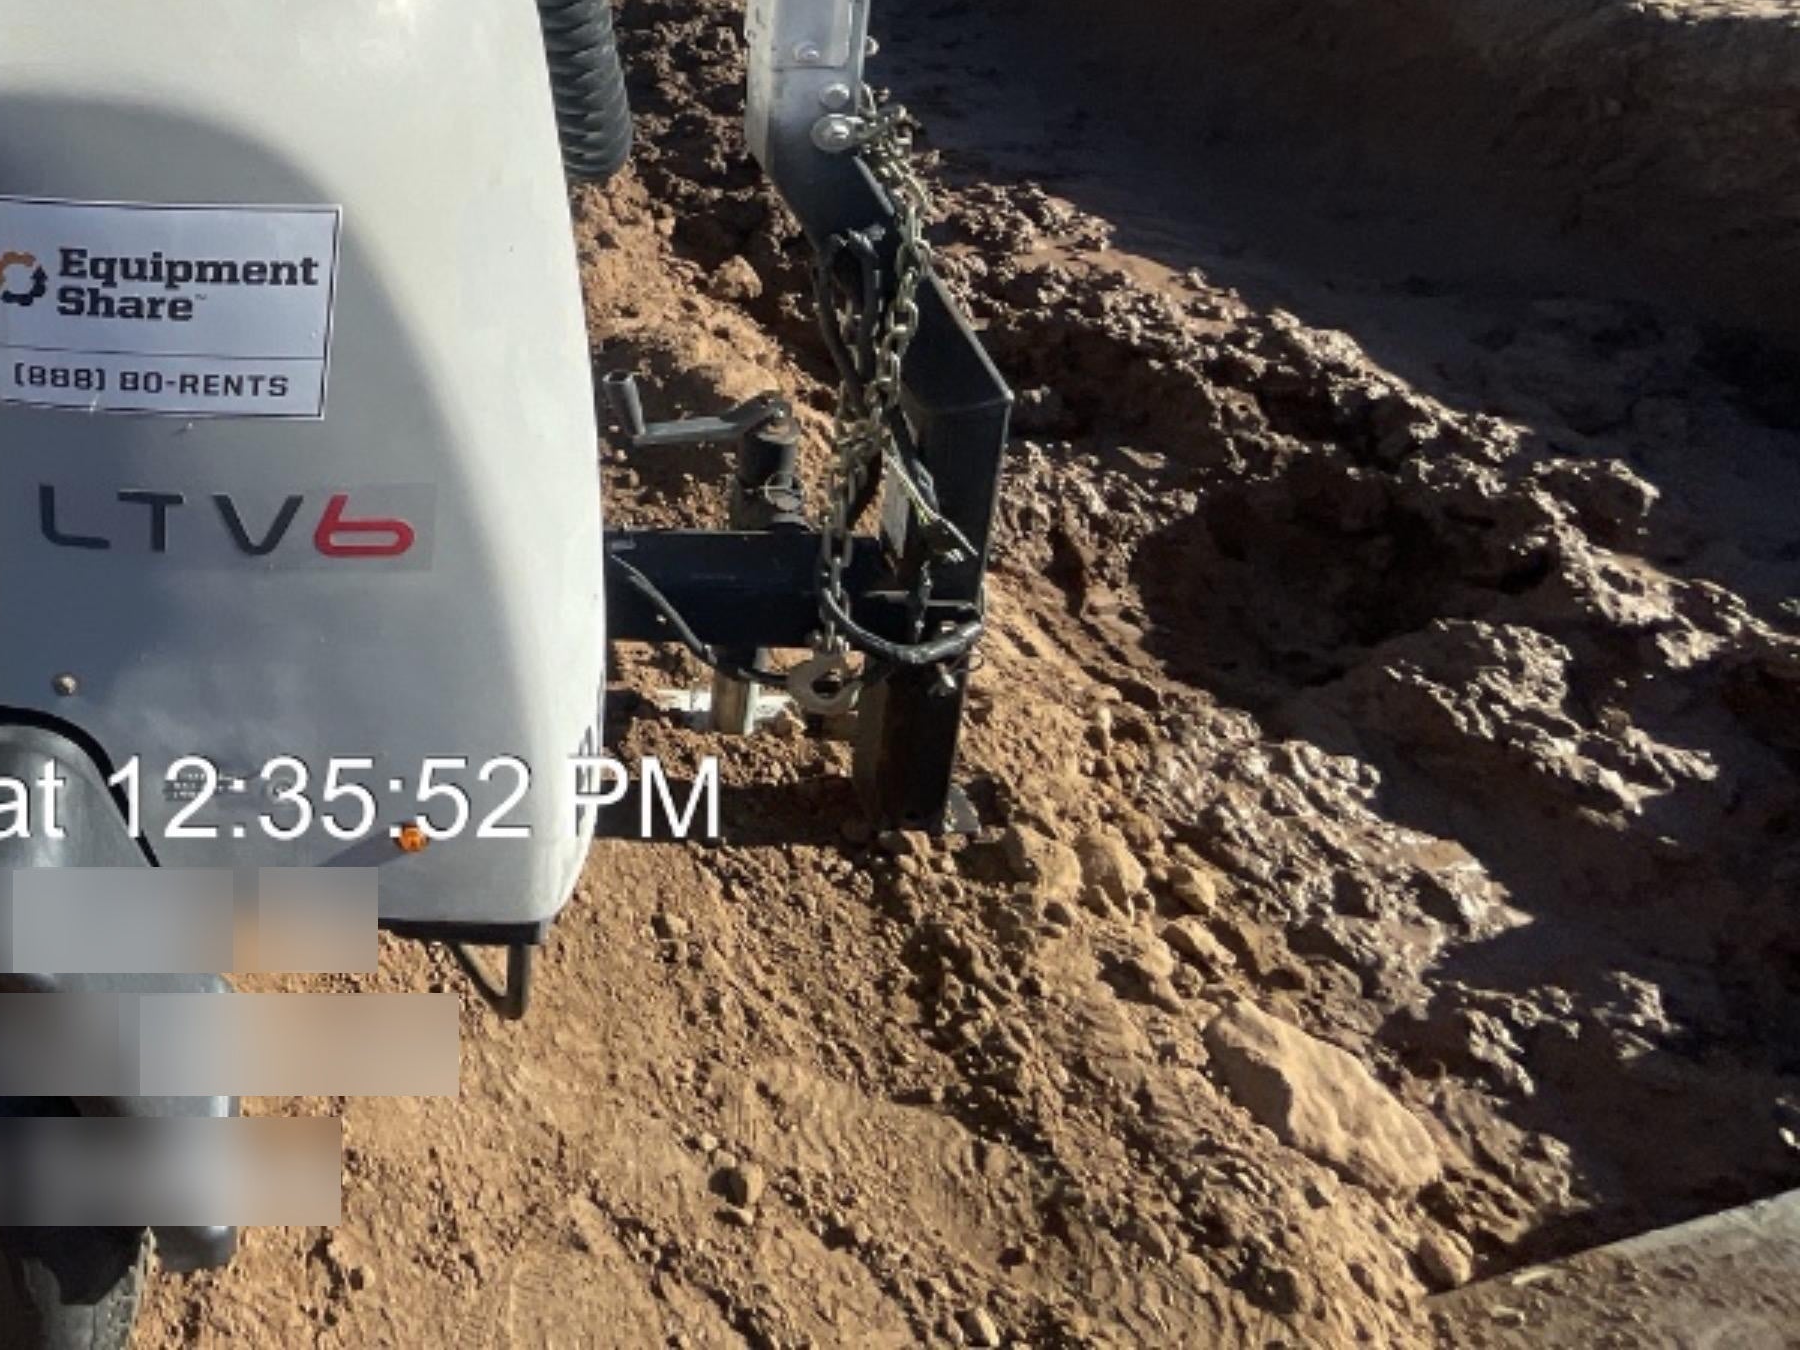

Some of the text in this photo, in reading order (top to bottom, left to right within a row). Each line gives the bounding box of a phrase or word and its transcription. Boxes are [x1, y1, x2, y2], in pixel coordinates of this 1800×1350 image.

[57, 247, 319, 290] Equipment
[57, 286, 194, 321] Share
[14, 362, 289, 397] (888) 80-RENTS
[38, 483, 416, 558] LTV6
